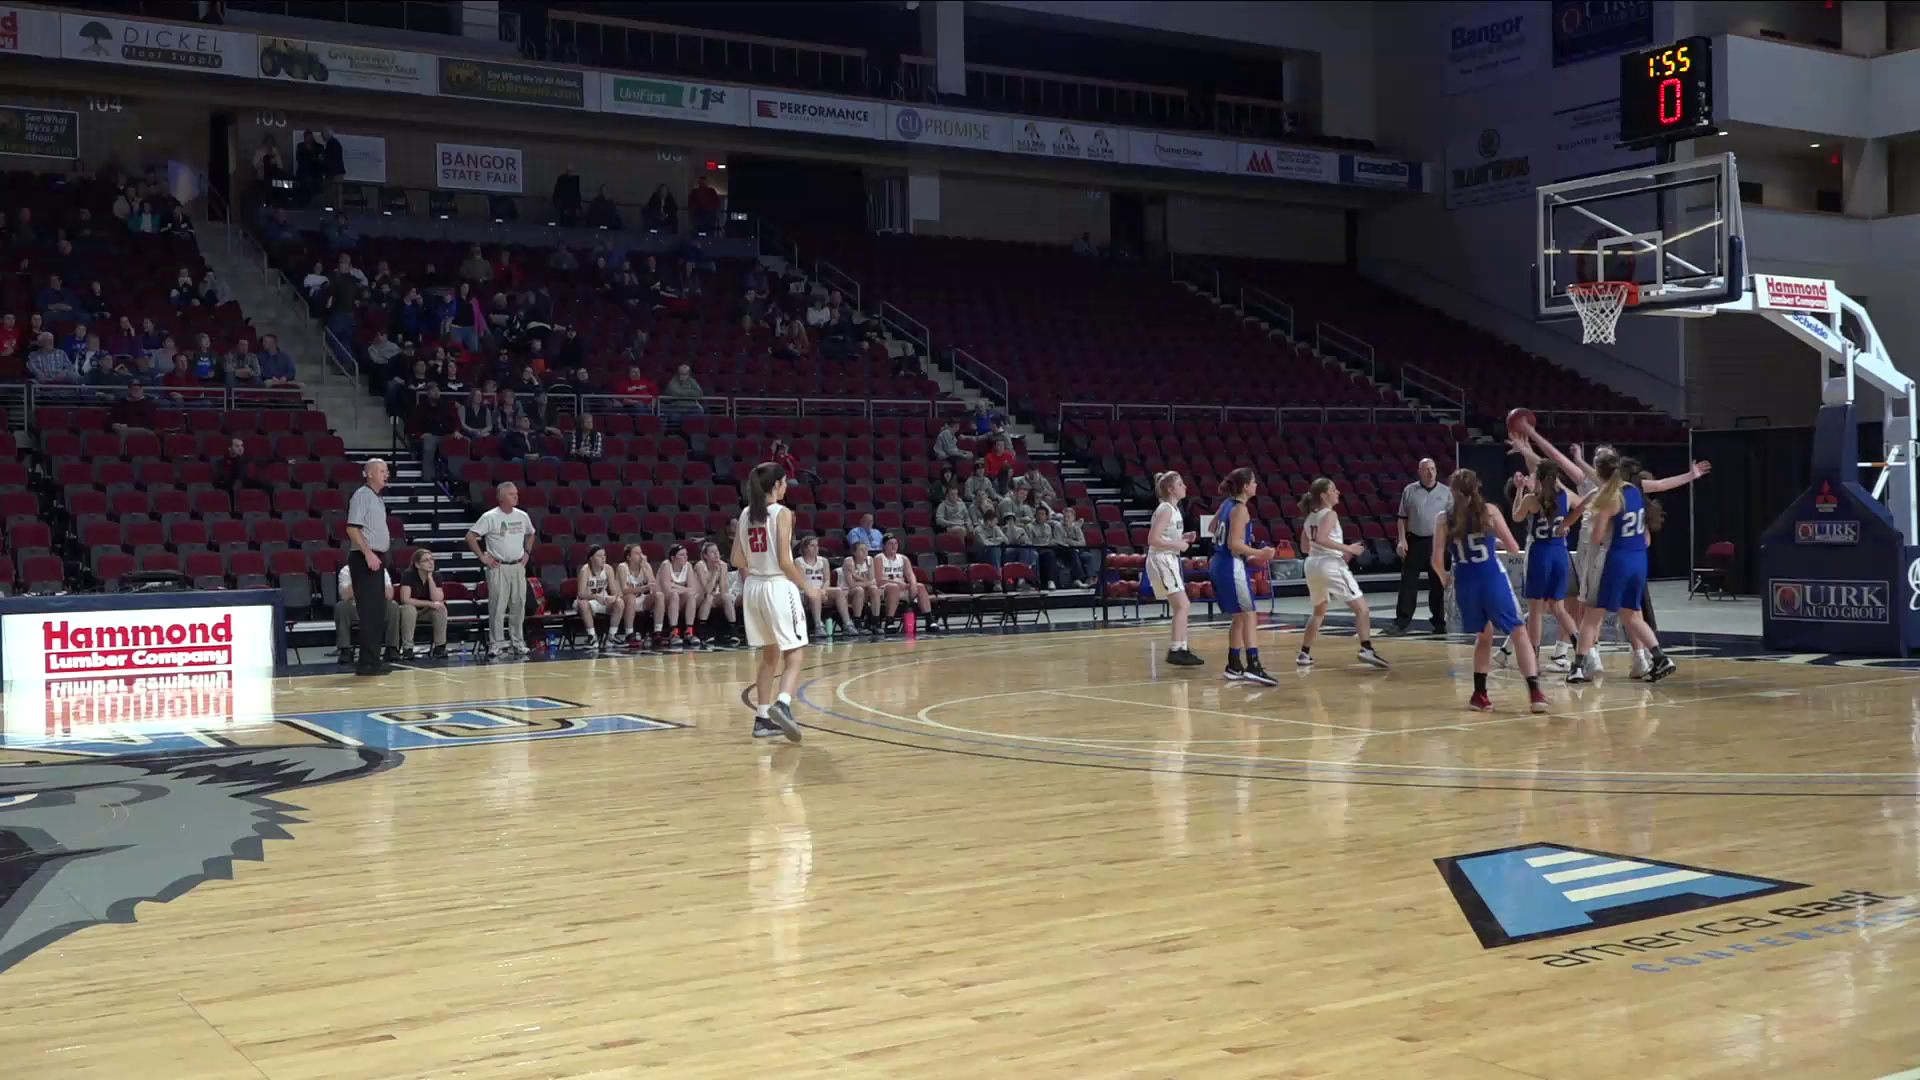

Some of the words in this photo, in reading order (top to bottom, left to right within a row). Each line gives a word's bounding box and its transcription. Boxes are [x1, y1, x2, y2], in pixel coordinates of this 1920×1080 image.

[124, 26, 223, 53] DICKEL
[1451, 16, 1524, 50] Bangor
[124, 47, 162, 60] Floor
[171, 51, 221, 67] Supply
[1649, 46, 1690, 77] 1:55
[88, 96, 123, 113] 104
[619, 87, 667, 104] UniFirst
[1660, 78, 1681, 124] 0
[780, 102, 869, 122] PERFORMANCE
[898, 115, 920, 134] CU
[925, 119, 990, 141] PROMISE
[441, 152, 516, 171] BANGOR
[442, 168, 481, 183] STATE
[486, 171, 518, 184] FAIR
[1766, 277, 1827, 296] Hammond
[1792, 311, 1829, 340] Schelde
[1621, 508, 1645, 537] 20
[1798, 523, 1857, 540] QUIRK
[748, 527, 768, 552] 23
[1453, 532, 1489, 563] 15
[1775, 585, 1885, 616] QUIRK
[1804, 605, 1840, 618] AUTO
[1840, 607, 1886, 619] GROUP
[43, 614, 233, 650] Hammond
[50, 651, 128, 670] Lumber
[131, 648, 228, 667] Company
[1527, 915, 1782, 969] america
[1767, 889, 1905, 919] east
